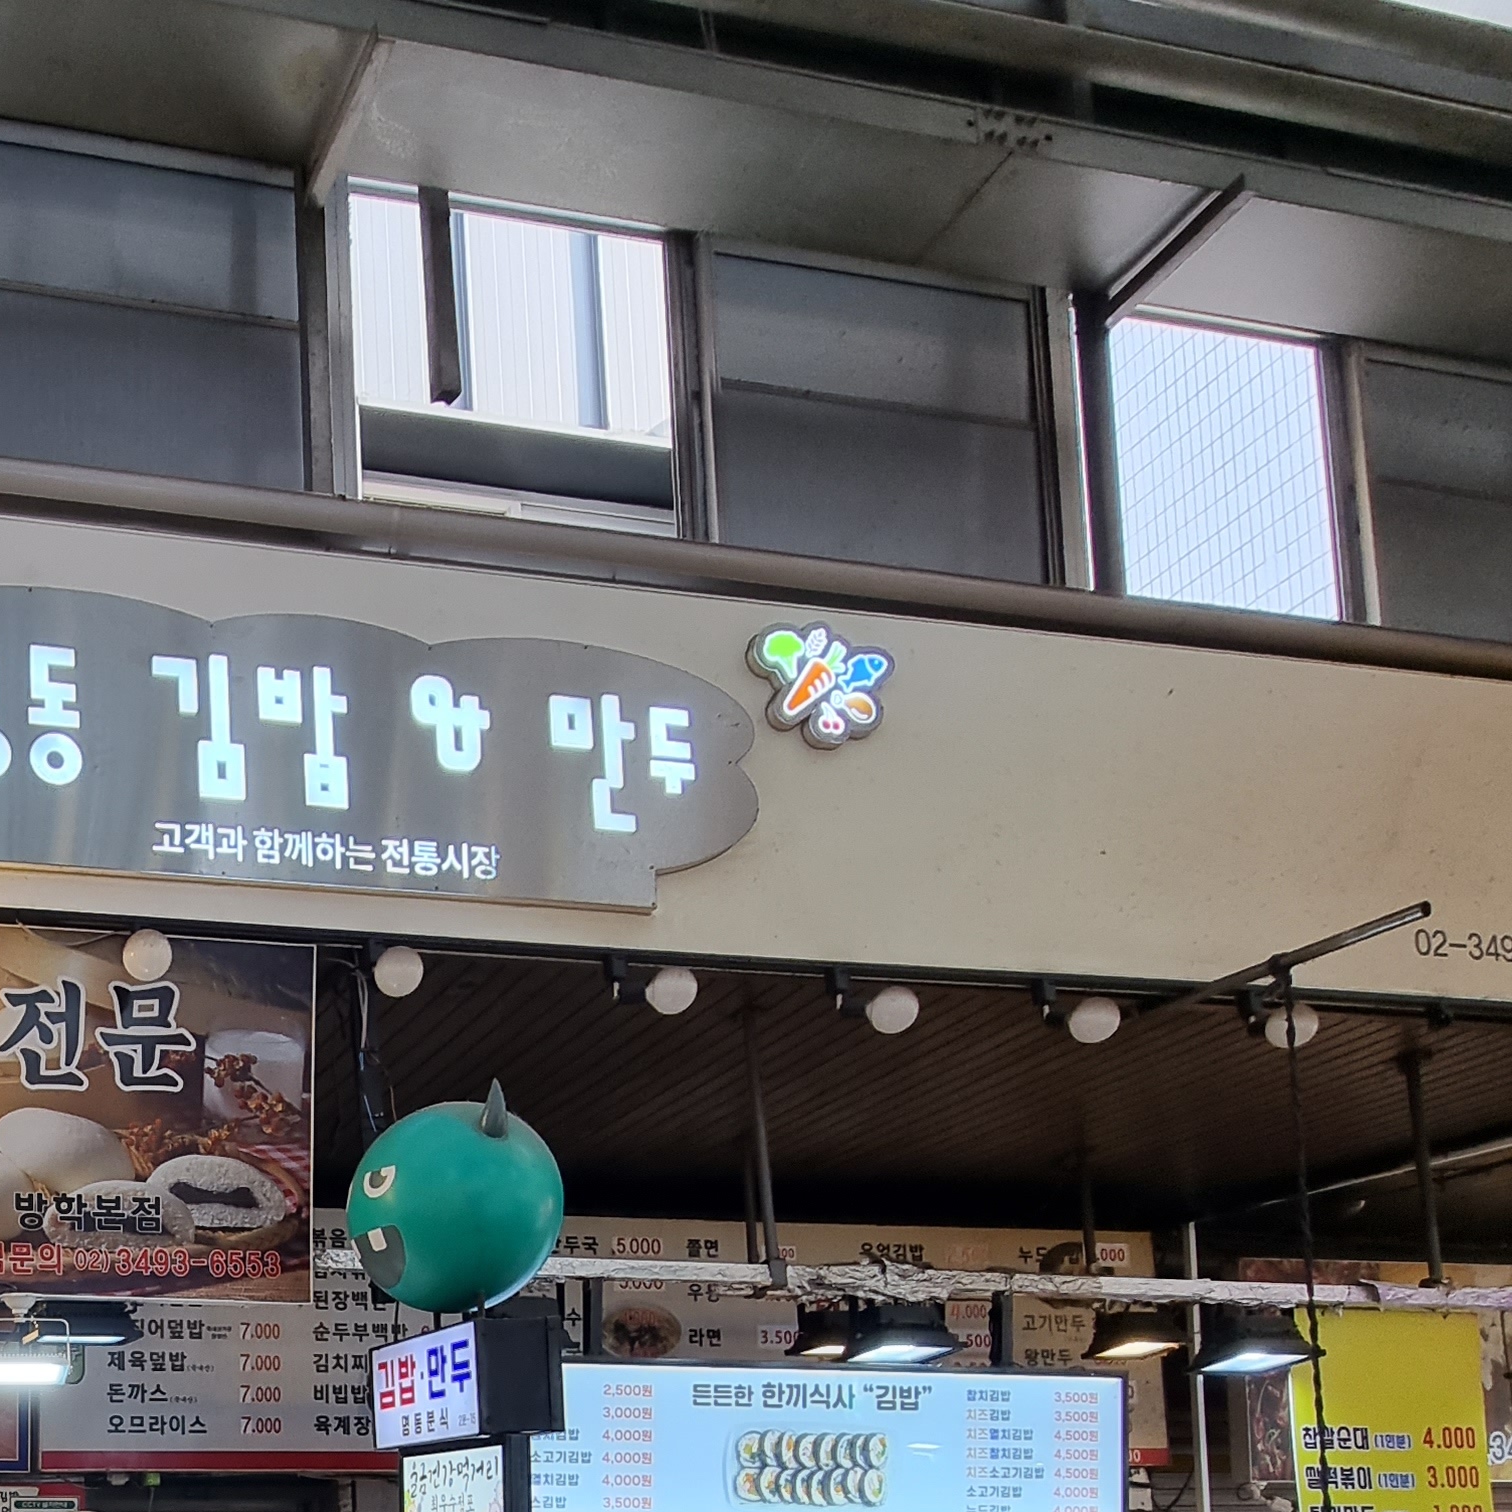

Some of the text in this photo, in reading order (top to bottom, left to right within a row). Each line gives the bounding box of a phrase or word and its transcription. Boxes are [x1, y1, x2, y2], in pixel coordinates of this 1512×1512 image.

[151, 653, 350, 809] 김밥
[549, 693, 697, 832] 만두
[152, 821, 500, 880] 고객과 함께하는 전통시장
[14, 1192, 162, 1233] 방학본점
[74, 1249, 109, 1274] 02)
[115, 1248, 282, 1279] 3493-6553
[1022, 1314, 1086, 1332] 고기만두
[688, 1328, 722, 1347] 라면
[108, 1350, 280, 1372] 제육덮밥 7.000
[1024, 1349, 1072, 1366] 왕만두
[107, 1383, 281, 1404] 돈까스 7.000
[313, 1383, 369, 1405] 비빔밥
[603, 1384, 653, 1398] 2,500원
[692, 1383, 754, 1408] 든든한
[761, 1382, 856, 1410] 한끼식사
[1054, 1391, 1099, 1405] 3,500원
[402, 1408, 449, 1436] 명동분식
[602, 1407, 653, 1421] 3,000원
[966, 1408, 1099, 1424] 치즈김밥 3,500원
[107, 1415, 282, 1437] 오므라이스 7.000
[602, 1429, 653, 1443] 4,000원
[1054, 1430, 1099, 1444] 4,500원
[1423, 1427, 1476, 1449] 4.000
[602, 1452, 653, 1466] 4,000원
[1054, 1449, 1099, 1462] 4,500원
[602, 1474, 653, 1488] 4,000원
[966, 1467, 1099, 1481] 치즈소고기김밥 4,500원
[1427, 1466, 1479, 1488] 3.000
[966, 1485, 1099, 1500] 소고기김밥 4,000원
[603, 1497, 653, 1511] 3,500원
